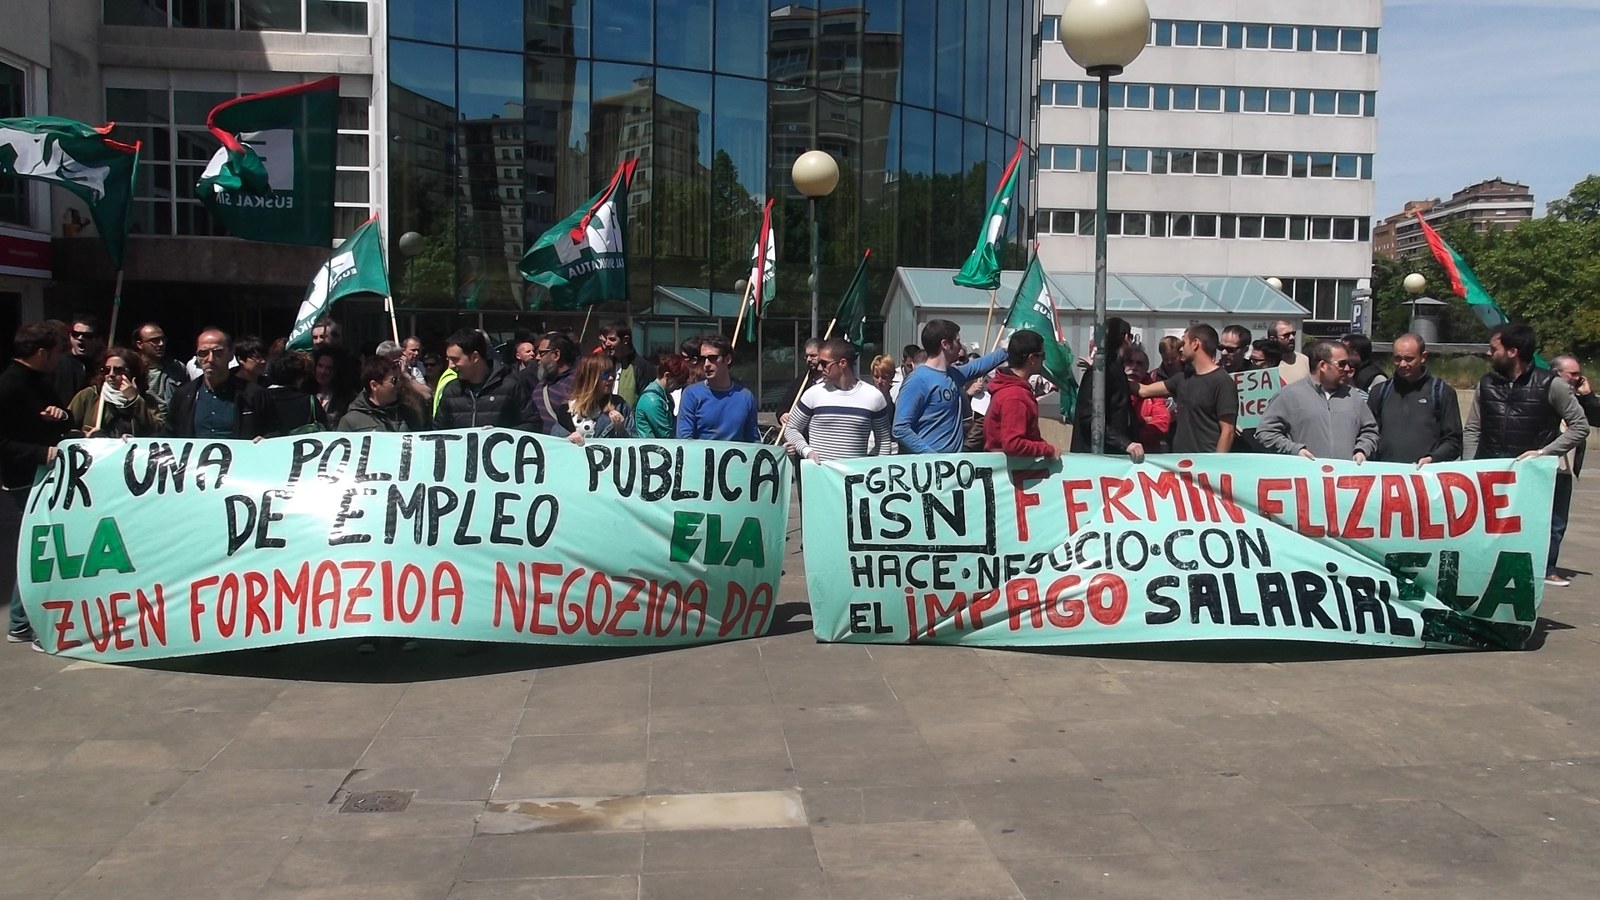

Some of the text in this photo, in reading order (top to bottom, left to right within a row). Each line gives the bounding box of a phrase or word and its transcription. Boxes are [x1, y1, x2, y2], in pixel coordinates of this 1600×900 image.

[1353, 304, 1361, 323] P
[124, 442, 232, 496] UNA
[289, 432, 544, 490] POLITICA
[585, 444, 780, 501] PUBLICA
[865, 460, 976, 494] GRUPO
[225, 483, 559, 556] DE EMPLEO
[669, 510, 765, 568] ELA
[859, 489, 968, 541] ISN
[30, 517, 136, 583] ELA
[42, 560, 774, 653] ZUEN FORMAZIOA NEGOZIOA DA
[850, 602, 894, 634] EL
